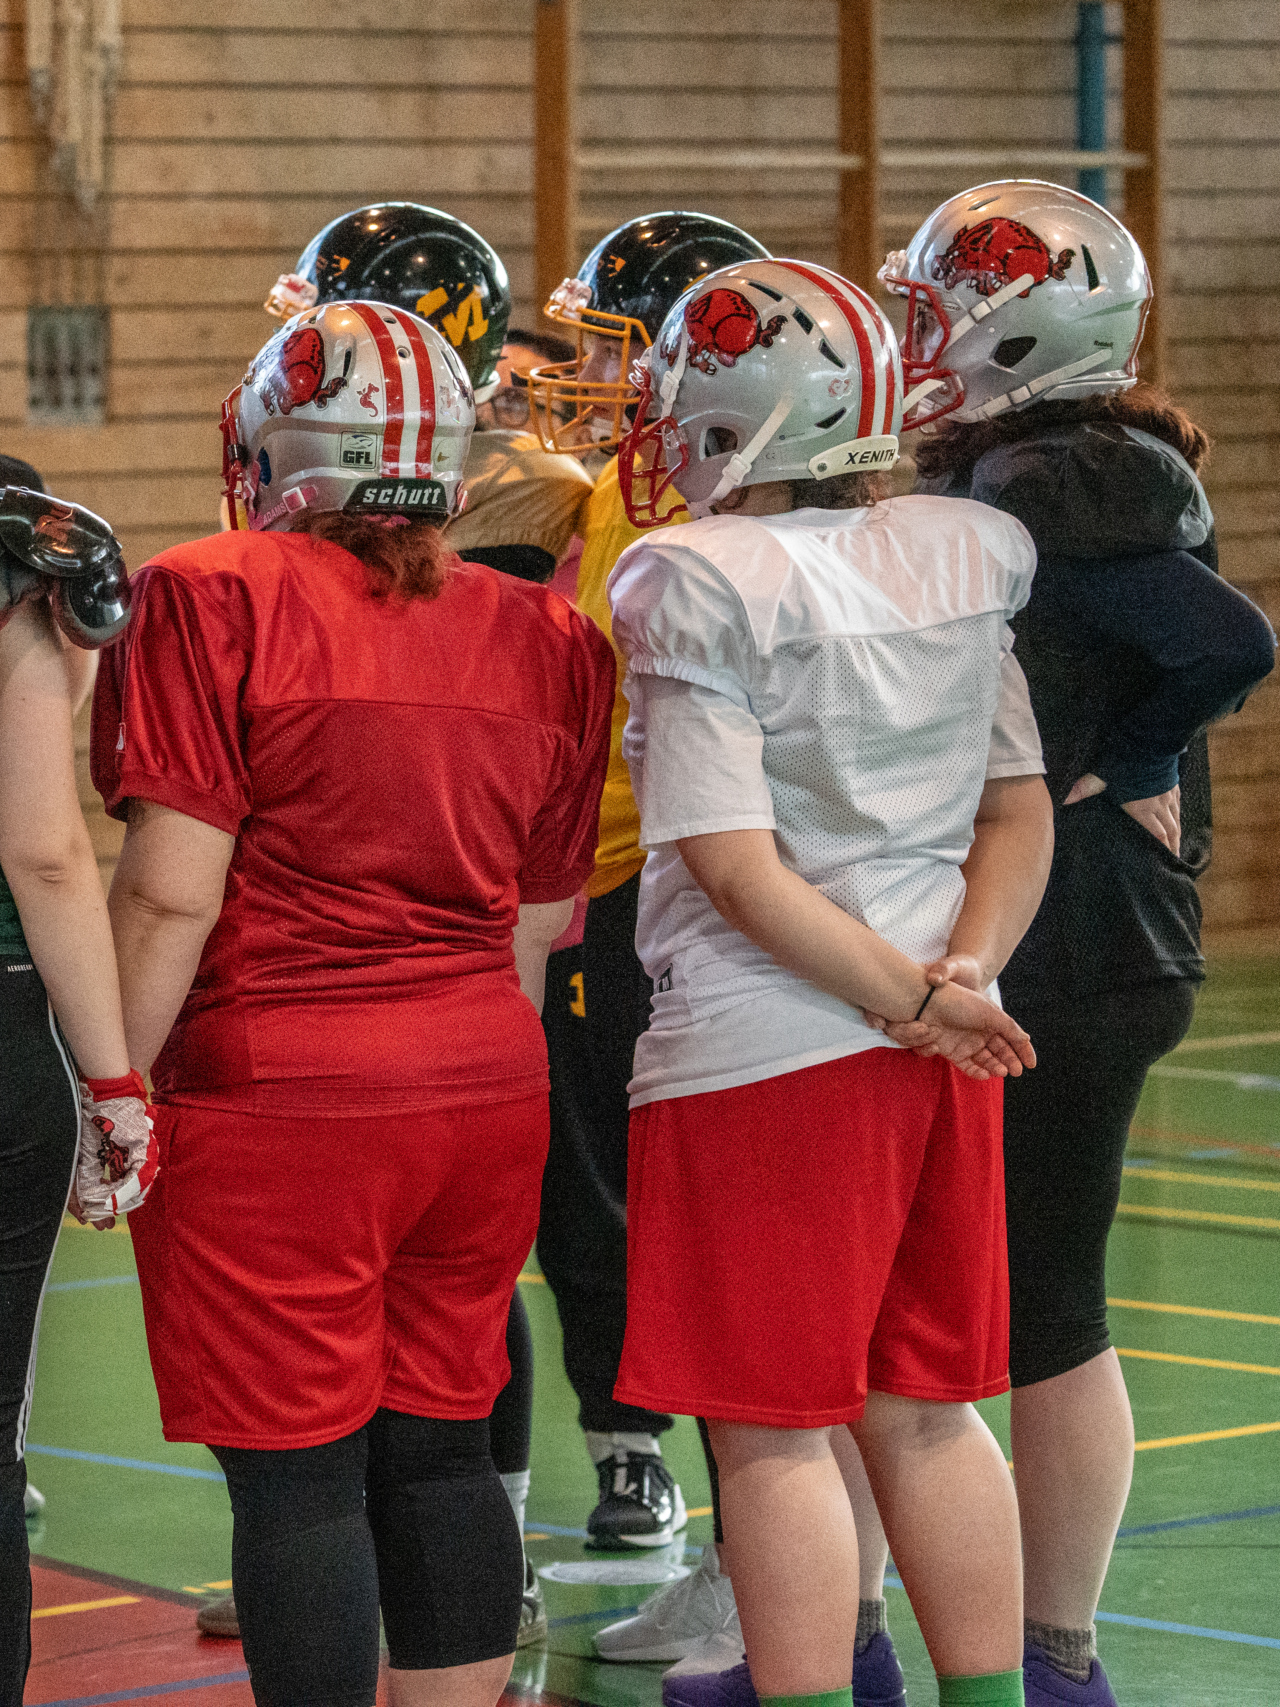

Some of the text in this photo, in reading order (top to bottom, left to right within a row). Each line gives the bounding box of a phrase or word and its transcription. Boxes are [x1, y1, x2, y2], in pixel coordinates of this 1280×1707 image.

[342, 450, 373, 465] GFL
[844, 448, 896, 466] XENITH
[362, 484, 442, 505] schutt
[262, 503, 288, 526] ADAMS
